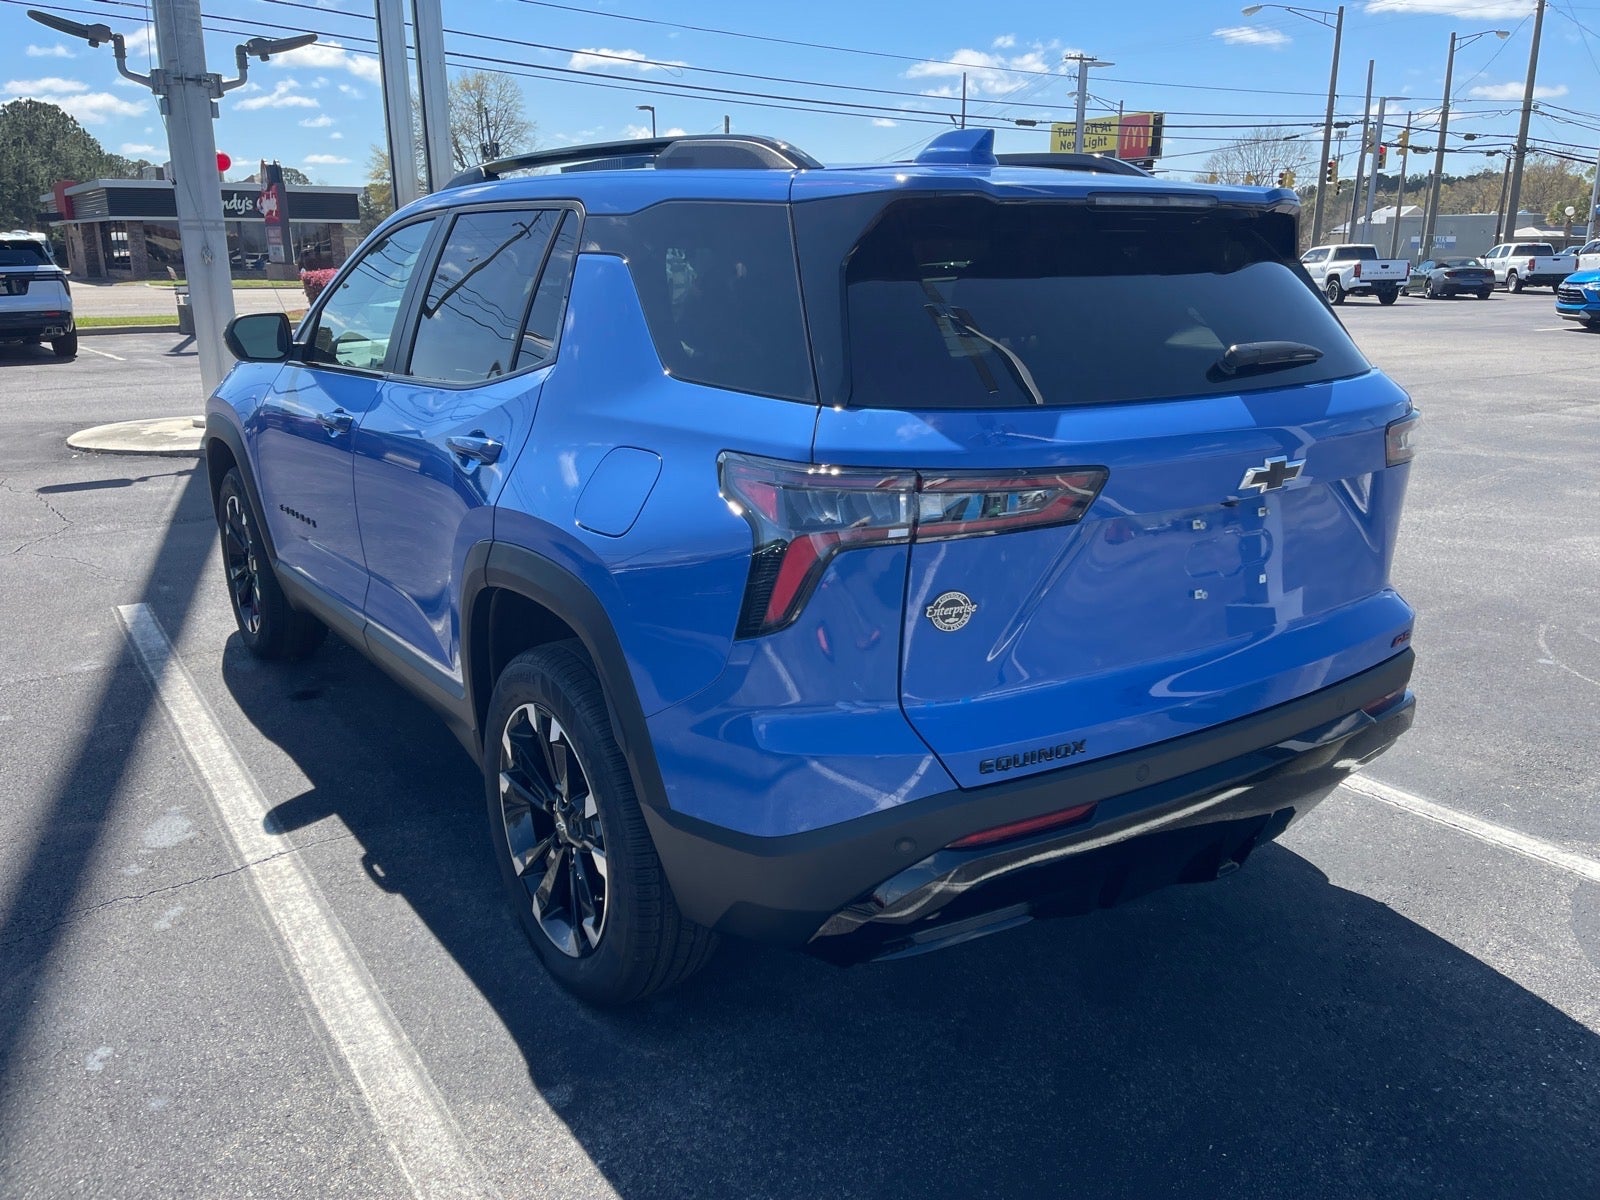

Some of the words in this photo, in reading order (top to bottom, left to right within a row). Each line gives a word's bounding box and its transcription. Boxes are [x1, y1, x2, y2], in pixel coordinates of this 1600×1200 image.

[1058, 127, 1077, 138] Turn
[1085, 122, 1098, 134] eft
[1101, 121, 1112, 133] At
[1060, 140, 1076, 151] Nex
[1084, 136, 1108, 149] Light
[223, 193, 254, 215] ndy's
[926, 604, 978, 618] Enterprise
[979, 739, 1087, 775] EQUINOX
